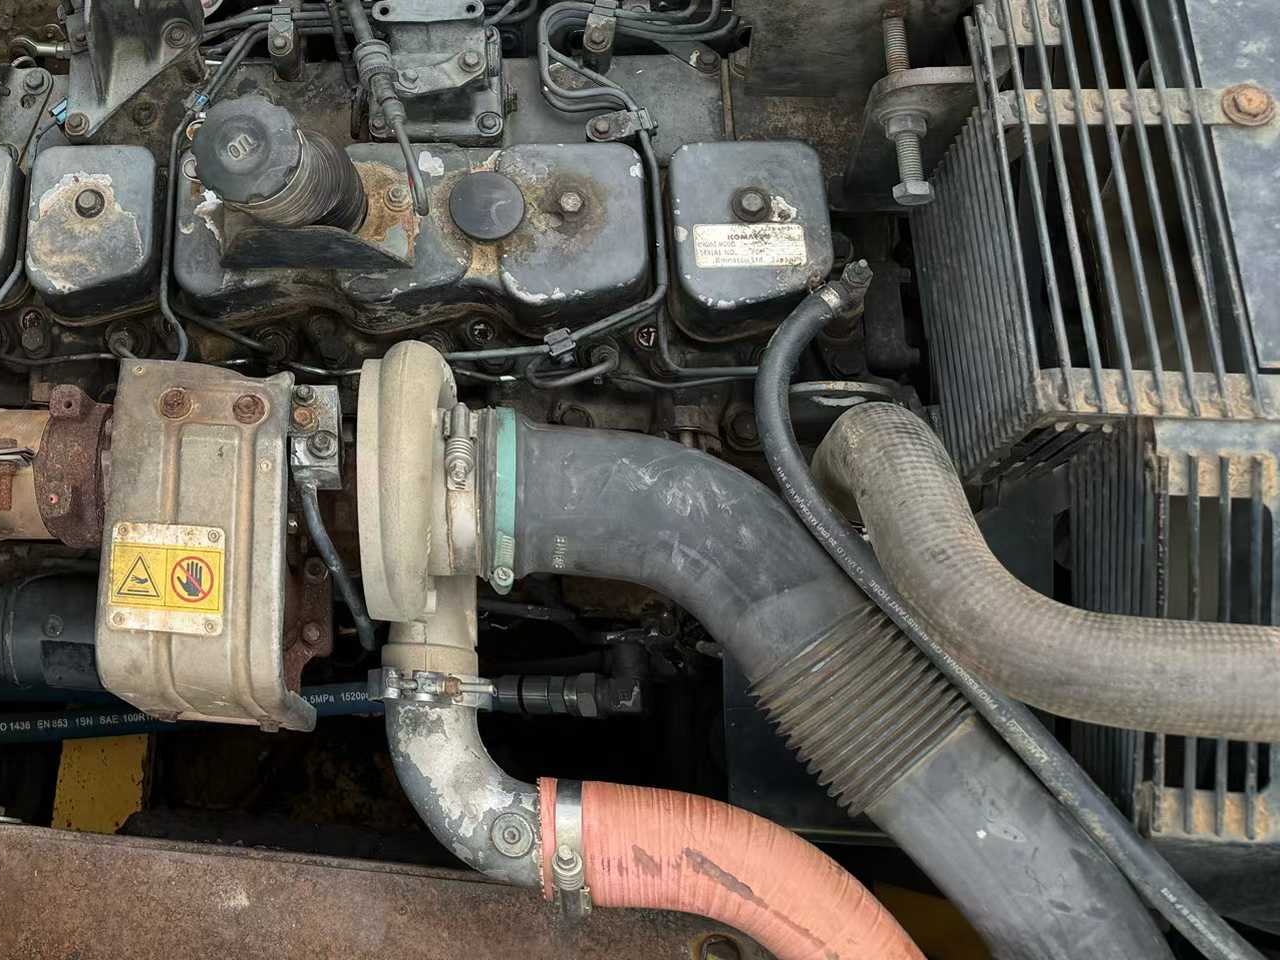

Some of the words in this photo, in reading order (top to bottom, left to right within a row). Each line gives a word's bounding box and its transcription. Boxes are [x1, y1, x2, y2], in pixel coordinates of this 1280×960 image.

[227, 134, 257, 160] OIL
[728, 233, 771, 241] KOMA
[868, 579, 891, 601] HOSE
[10, 720, 31, 730] 1436
[37, 719, 50, 729] EN
[75, 716, 93, 727] 1SN
[99, 714, 119, 725] SAE
